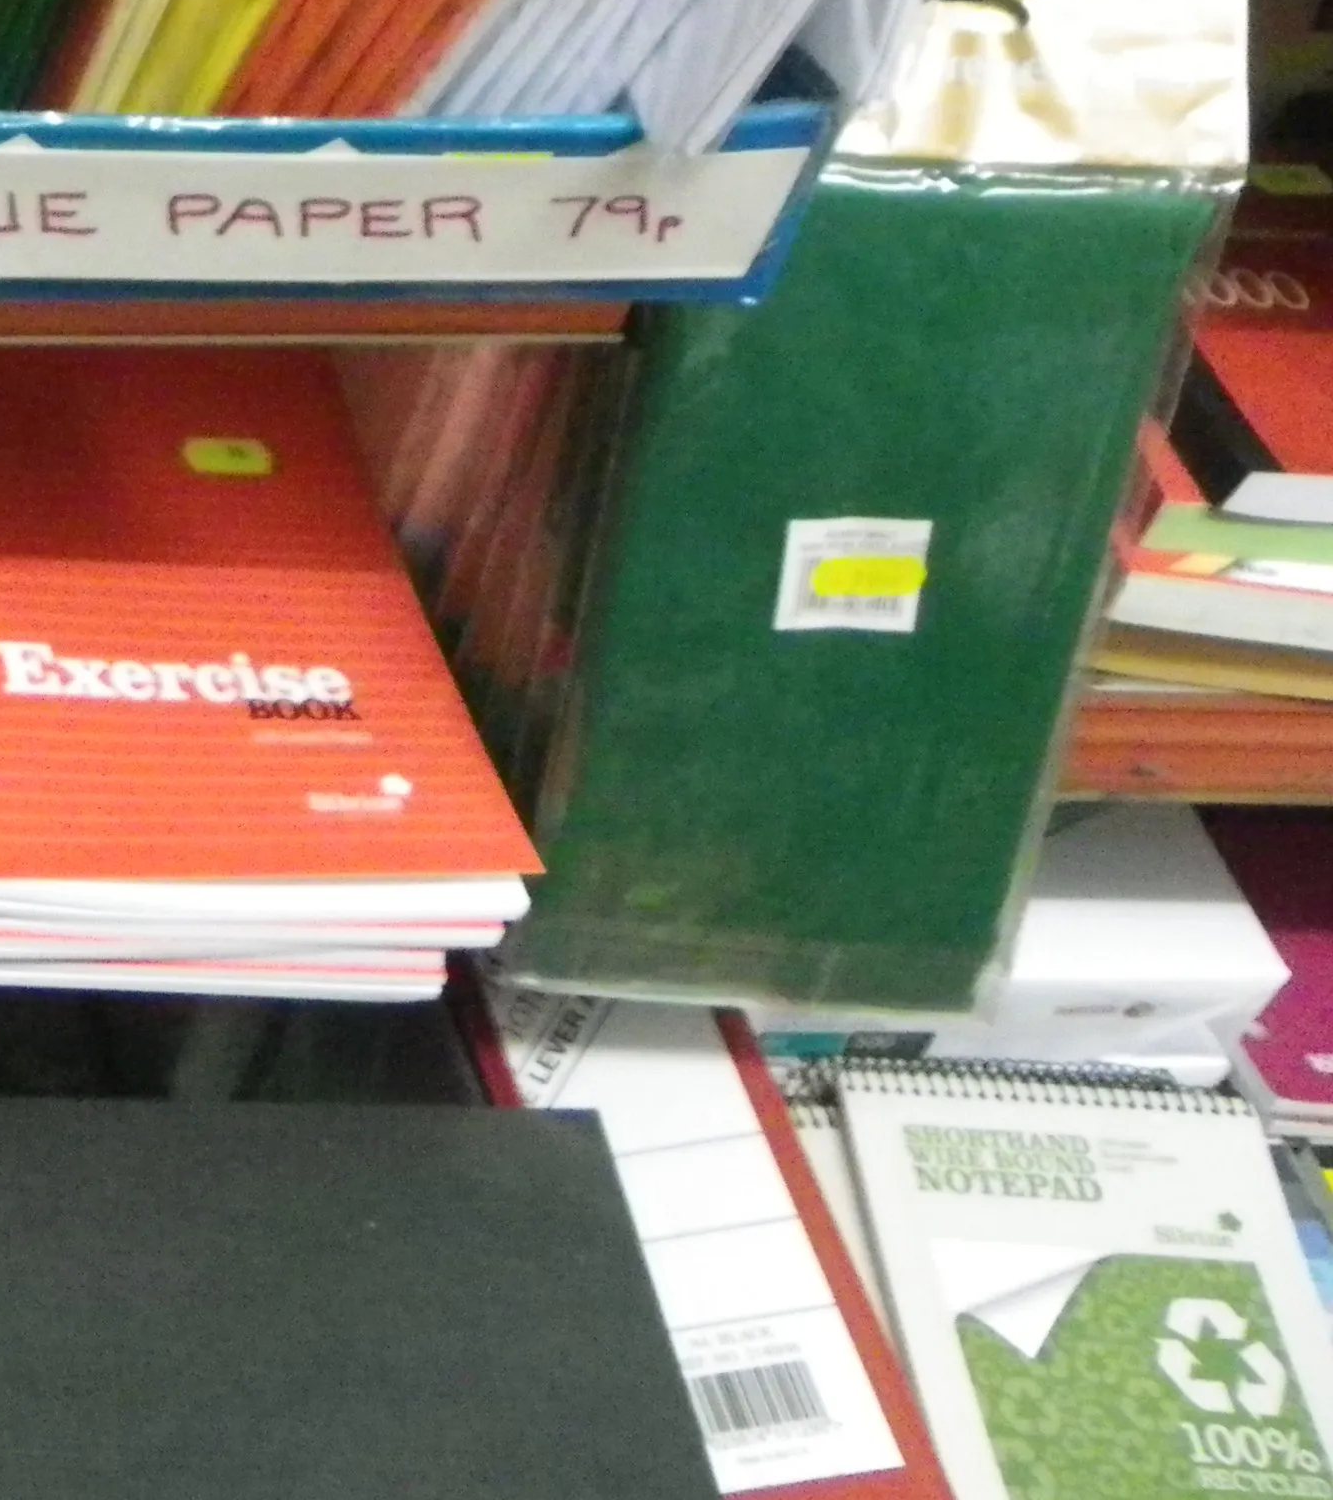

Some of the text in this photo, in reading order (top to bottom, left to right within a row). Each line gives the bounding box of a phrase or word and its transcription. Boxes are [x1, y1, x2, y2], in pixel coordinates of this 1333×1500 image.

[166, 192, 483, 243] PAPER
[245, 698, 364, 721] BOOK
[528, 1008, 587, 1085] LEVER
[901, 1123, 1091, 1156] SHORTHAND
[906, 1145, 984, 1169] WIRE
[993, 1150, 1098, 1176] BOUND
[912, 1165, 1105, 1202] NOTEPAD
[1179, 1421, 1322, 1474] 100%
